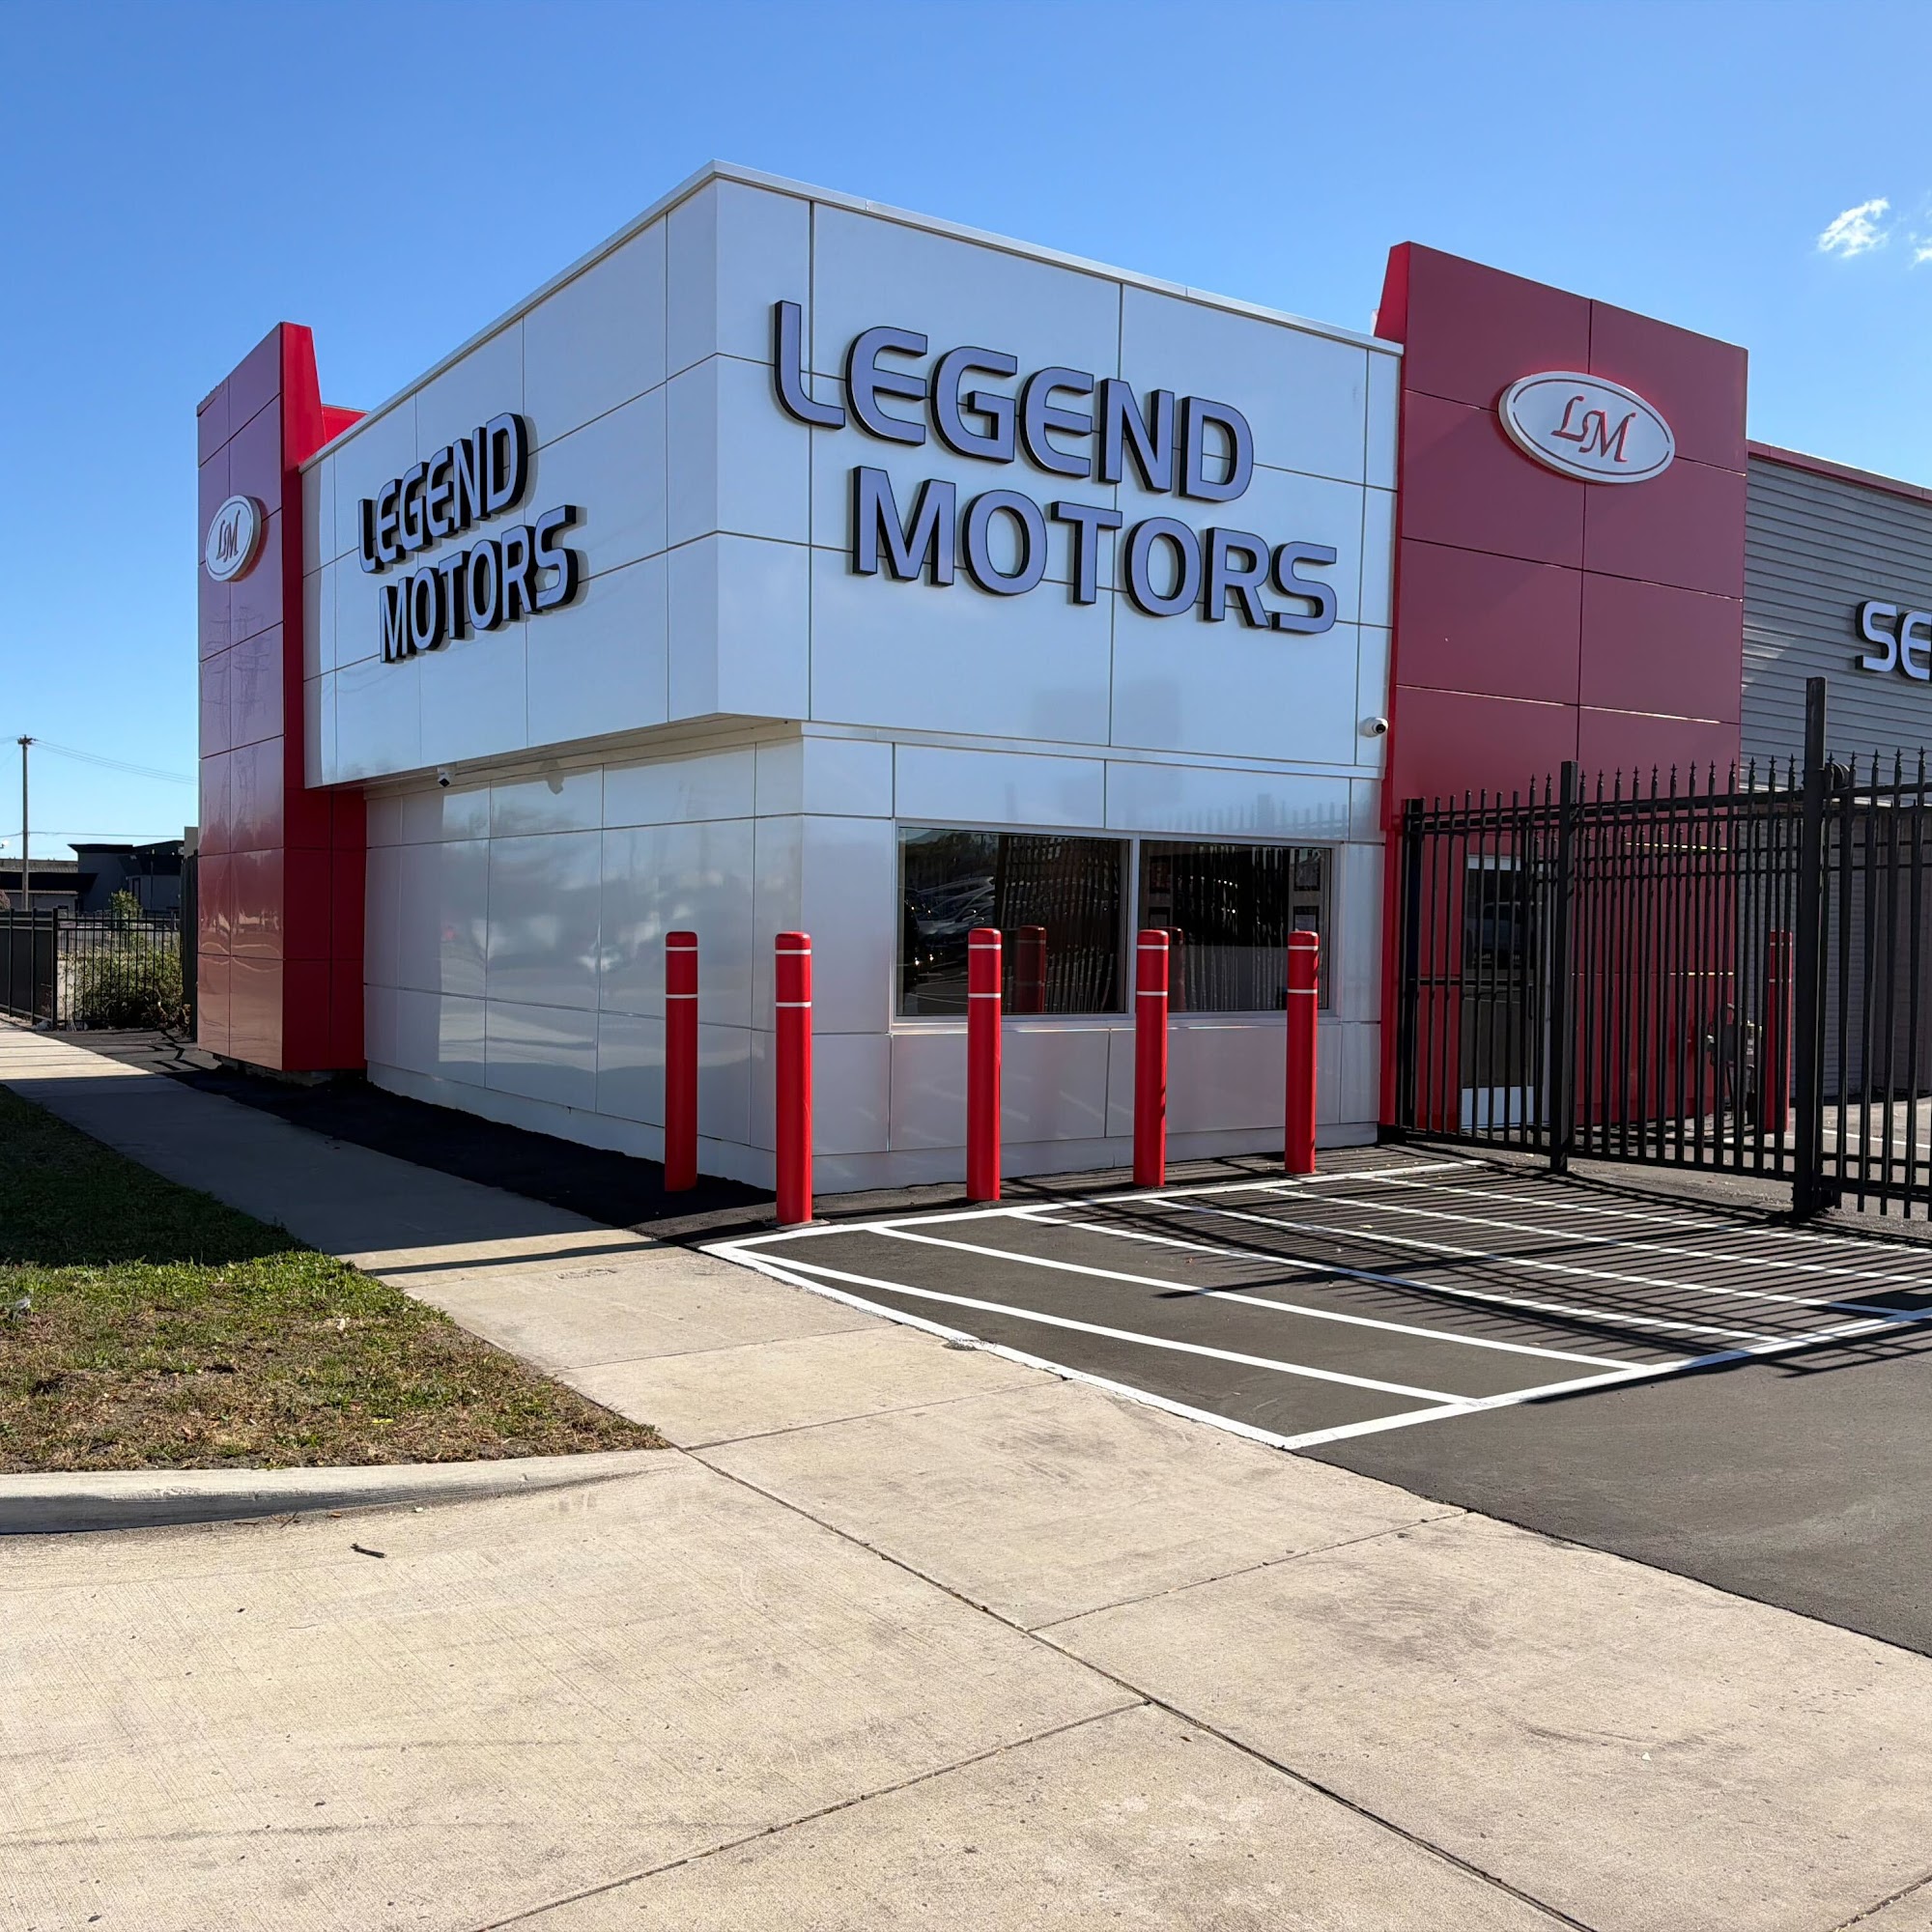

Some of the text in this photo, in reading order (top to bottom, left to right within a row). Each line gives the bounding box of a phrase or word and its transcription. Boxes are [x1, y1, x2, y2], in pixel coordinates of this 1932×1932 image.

[774, 299, 1254, 502] LEGEND
[1550, 395, 1636, 462] LM
[358, 412, 528, 574] LEGEND
[852, 466, 1338, 634] MOTORS
[380, 504, 579, 664] MOTORS
